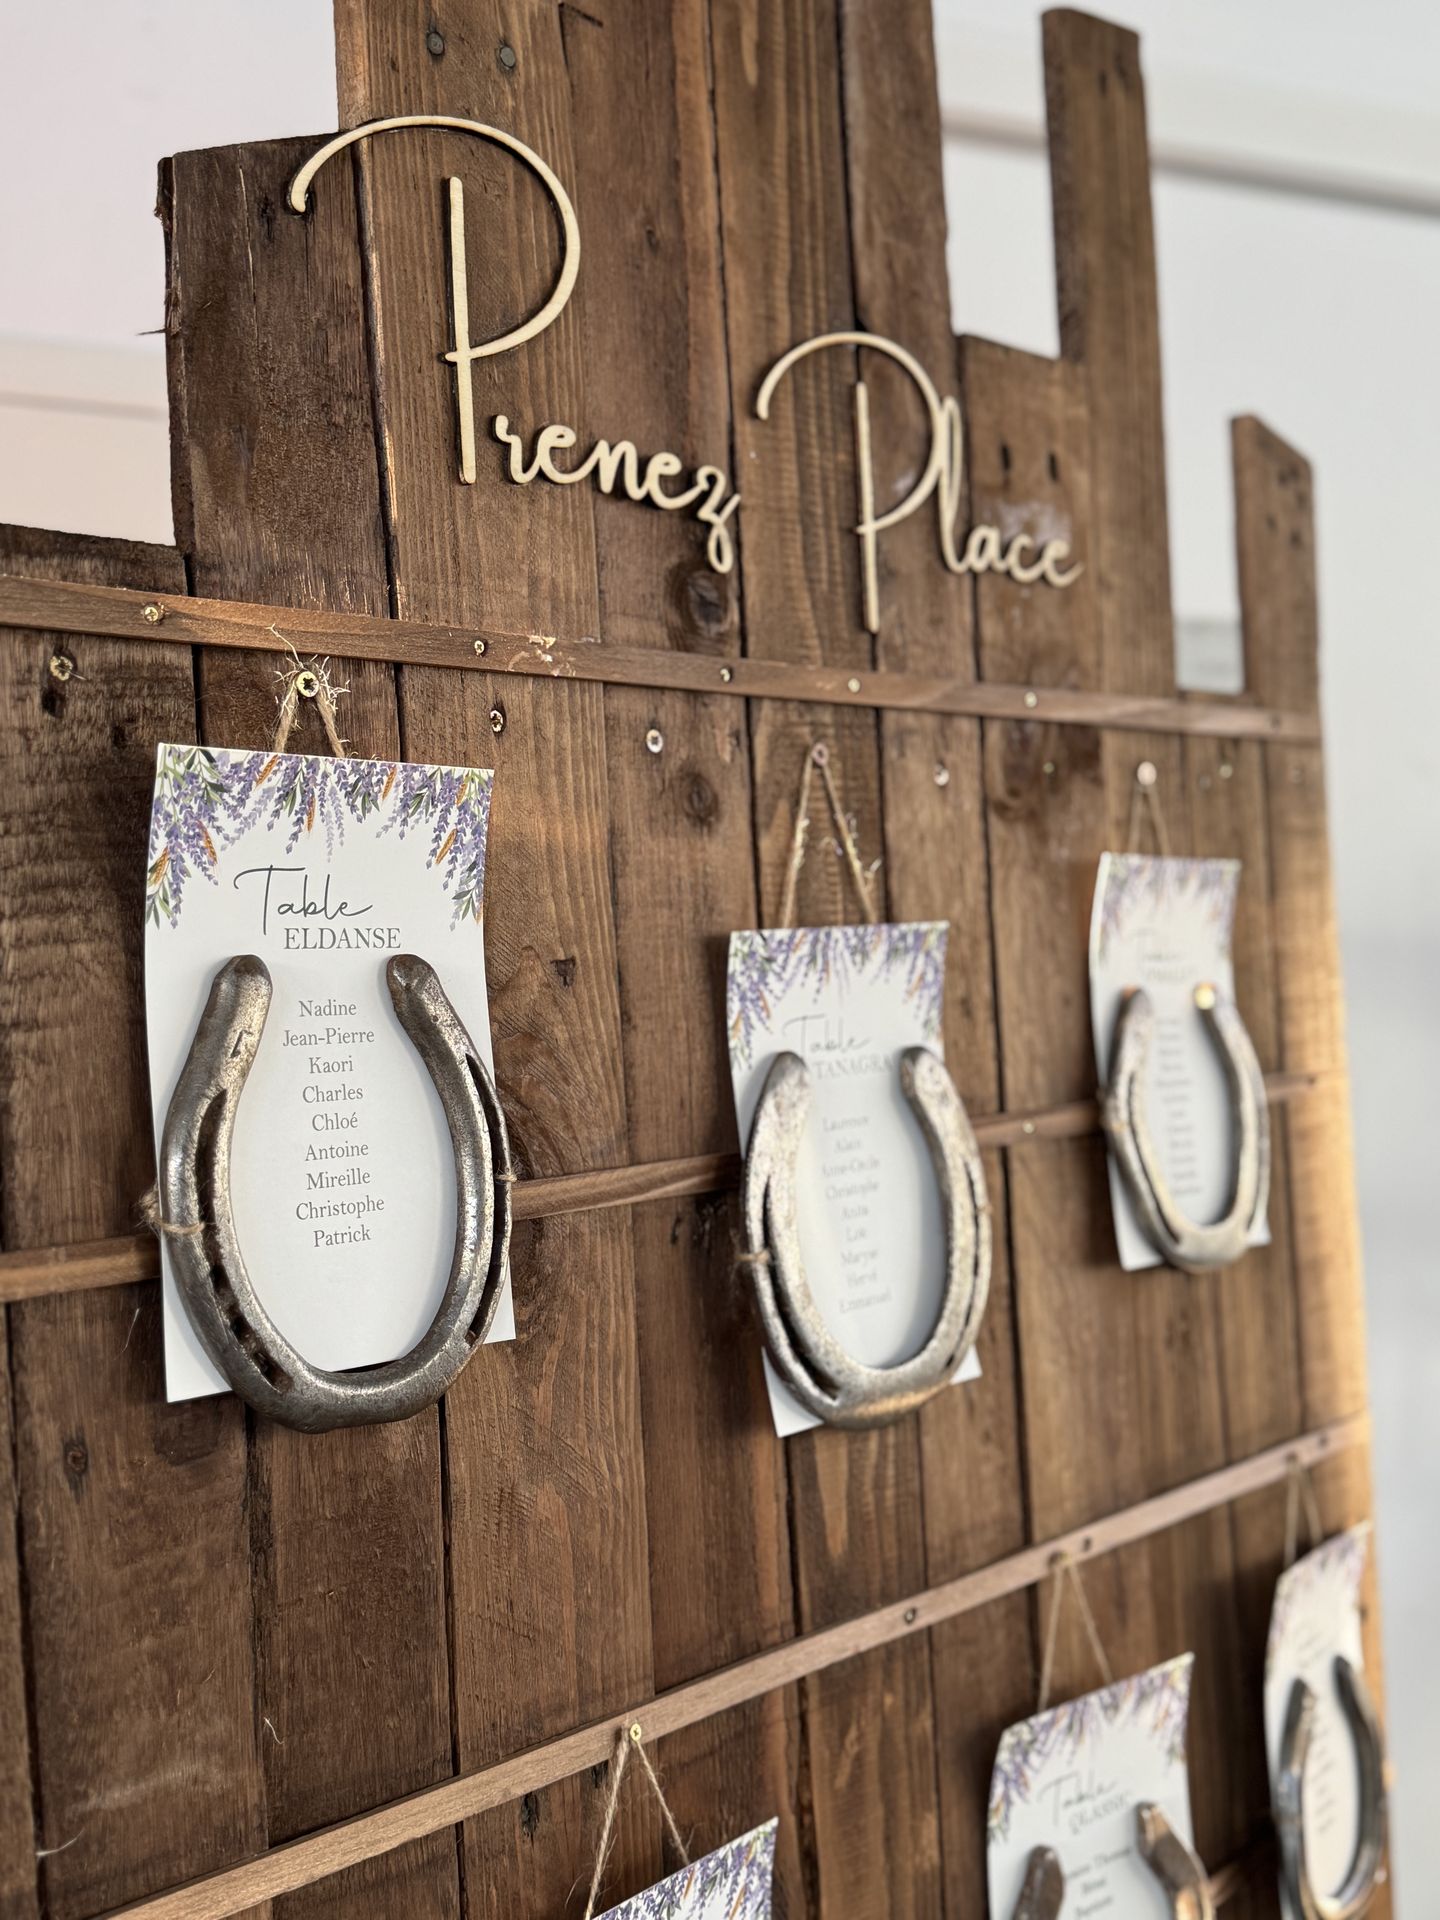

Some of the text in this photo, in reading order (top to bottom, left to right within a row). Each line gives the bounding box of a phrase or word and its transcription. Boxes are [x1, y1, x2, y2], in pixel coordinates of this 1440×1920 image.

[287, 114, 1084, 633] Prenez Place
[233, 864, 374, 936] Table
[283, 927, 402, 950] ELDANSE
[298, 999, 358, 1018] Nadine
[282, 1027, 376, 1048] Jean-Pierre
[308, 1055, 354, 1075] Kaori
[302, 1083, 364, 1104] Charles
[311, 1112, 359, 1132] Chloé
[304, 1140, 370, 1162] Antoine
[305, 1167, 371, 1191] Mireille
[295, 1195, 386, 1221] Christophe
[312, 1224, 372, 1248] Patrick
